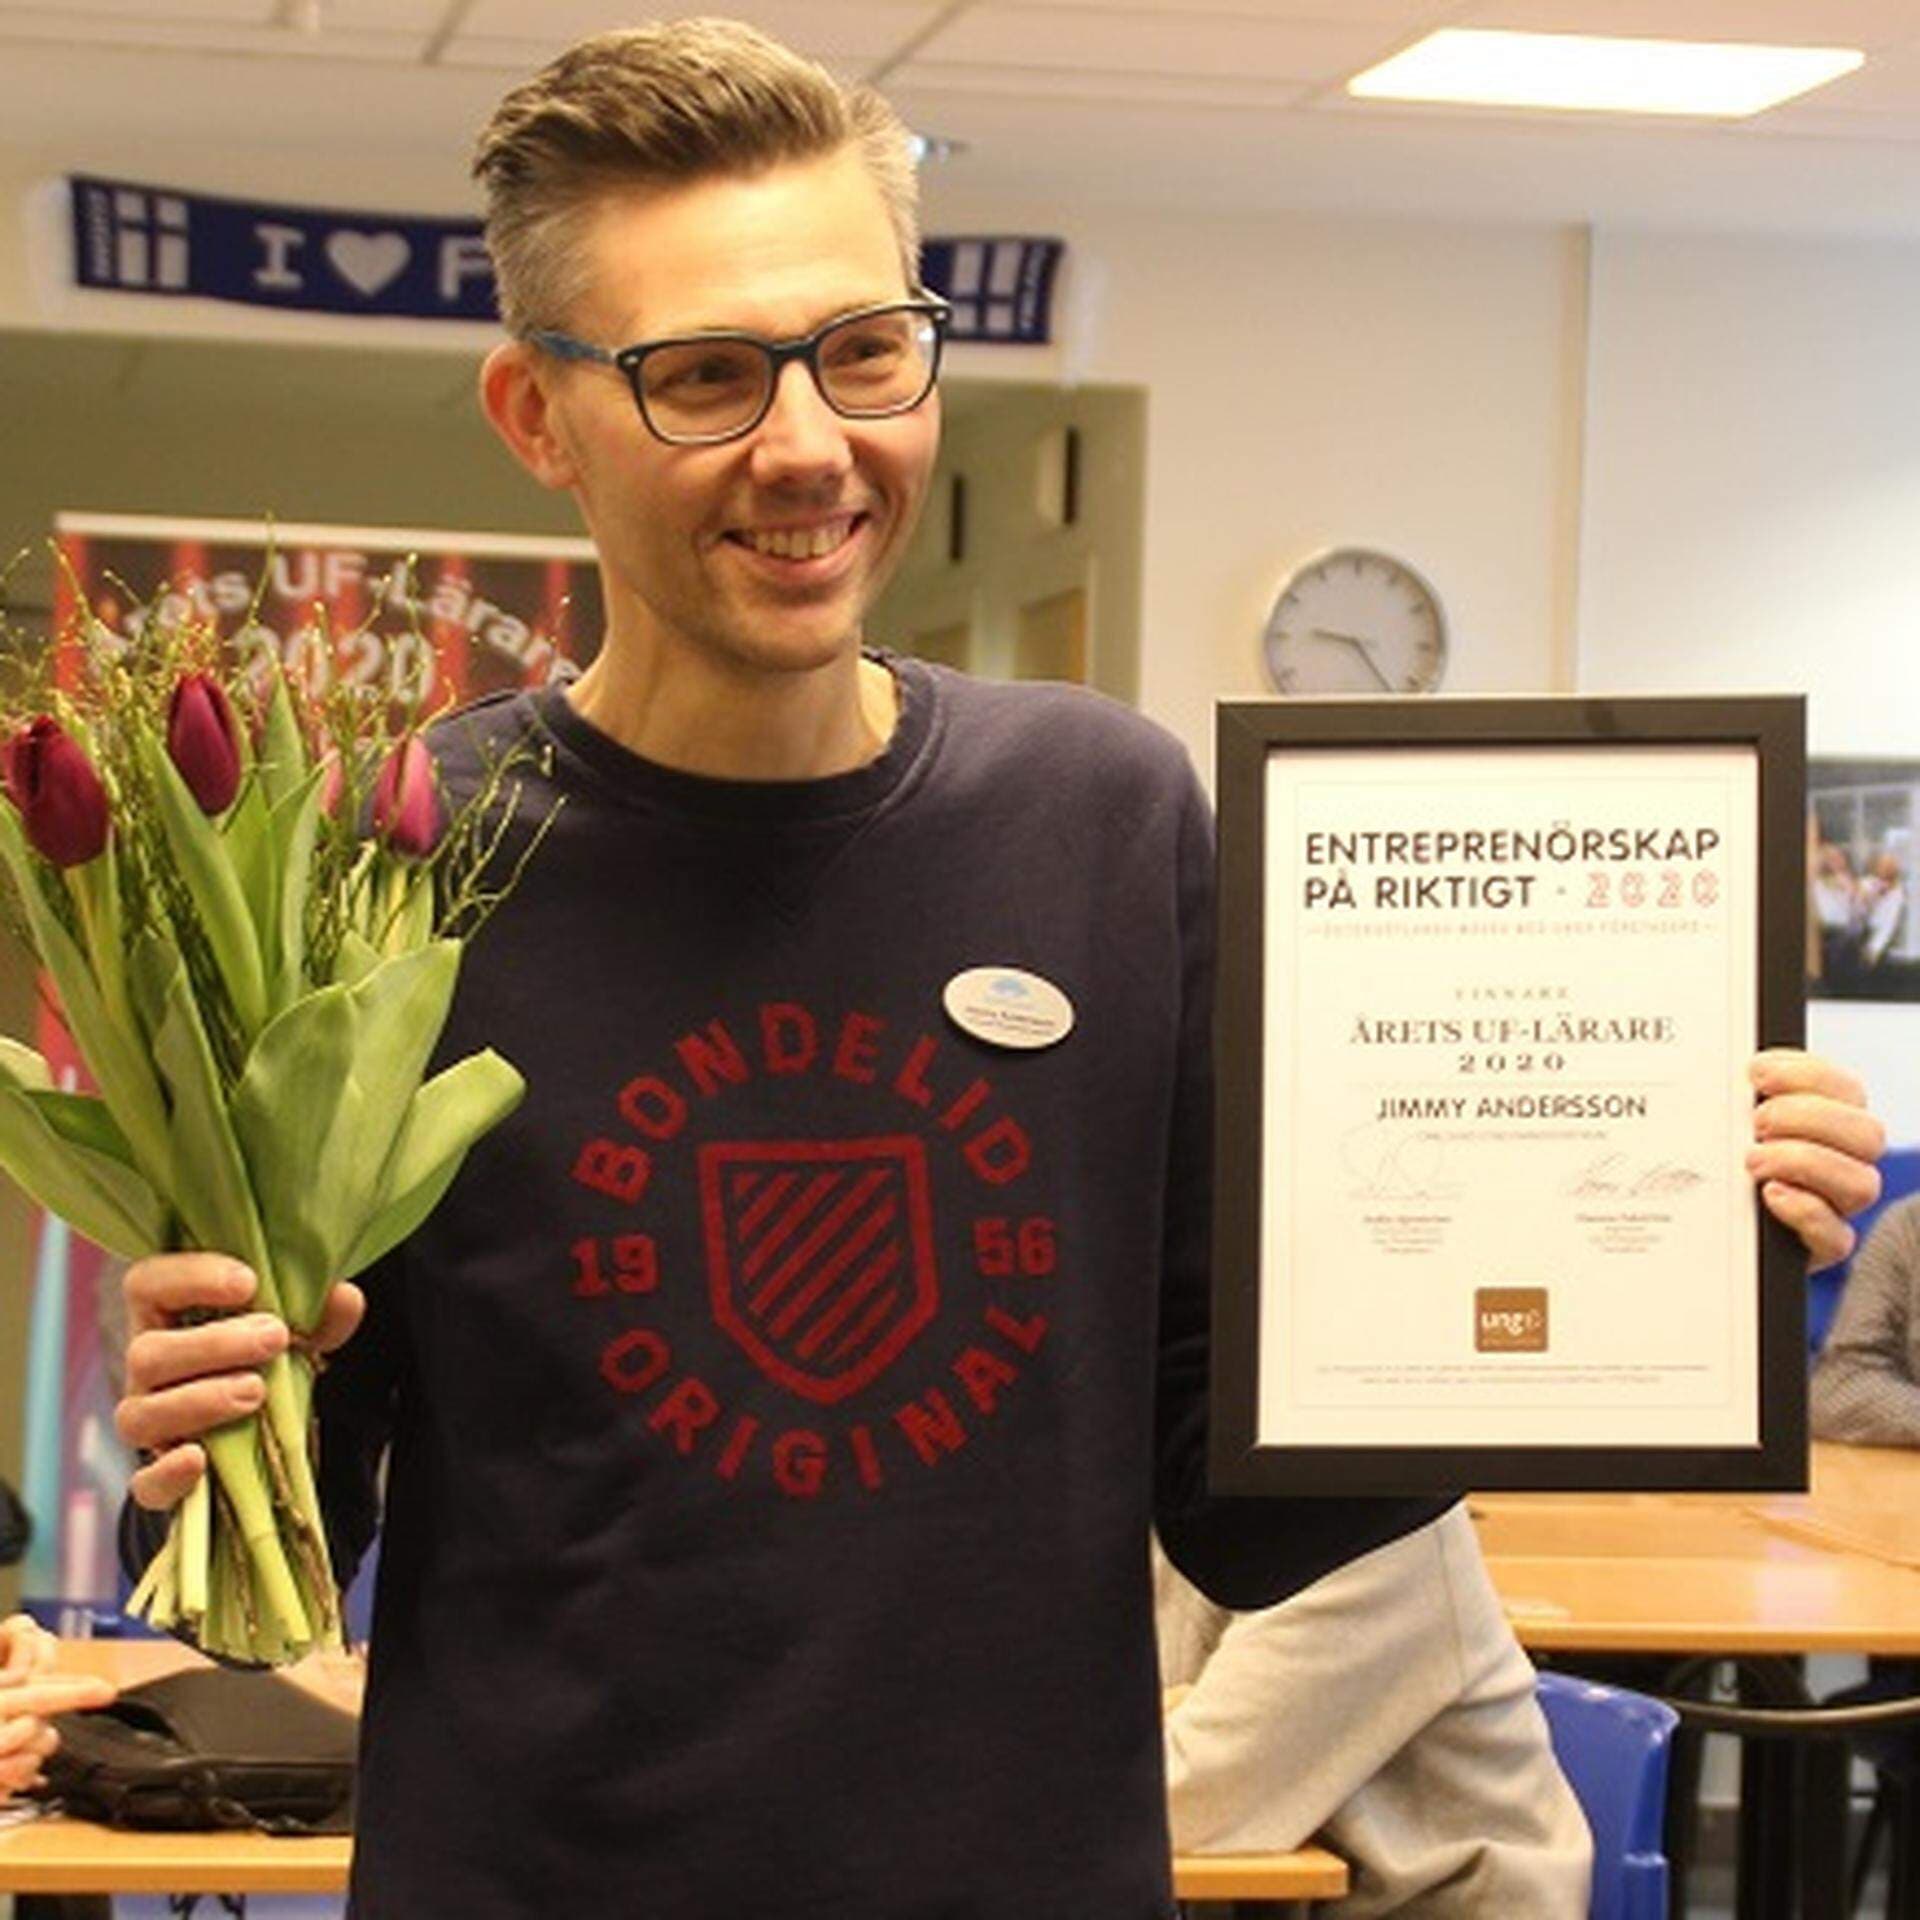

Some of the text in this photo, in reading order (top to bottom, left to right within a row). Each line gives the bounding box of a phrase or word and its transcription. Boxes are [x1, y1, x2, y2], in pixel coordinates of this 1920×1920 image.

[253, 223, 305, 289] I
[232, 622, 435, 704] 2020
[1306, 820, 1720, 865] ENTREPRENÖRSKAP
[1304, 868, 1720, 909] PÅ RIKTIGT 2020
[1350, 1011, 1676, 1045] ÅRETS UF-LÄRARE
[1458, 1052, 1566, 1074] 2020
[569, 1002, 1032, 1207] BONDELID
[1376, 1095, 1648, 1121] JIMMY ANDERSSON
[569, 1214, 1057, 1297] 19 56
[599, 1305, 1050, 1498] ORIGINAL
